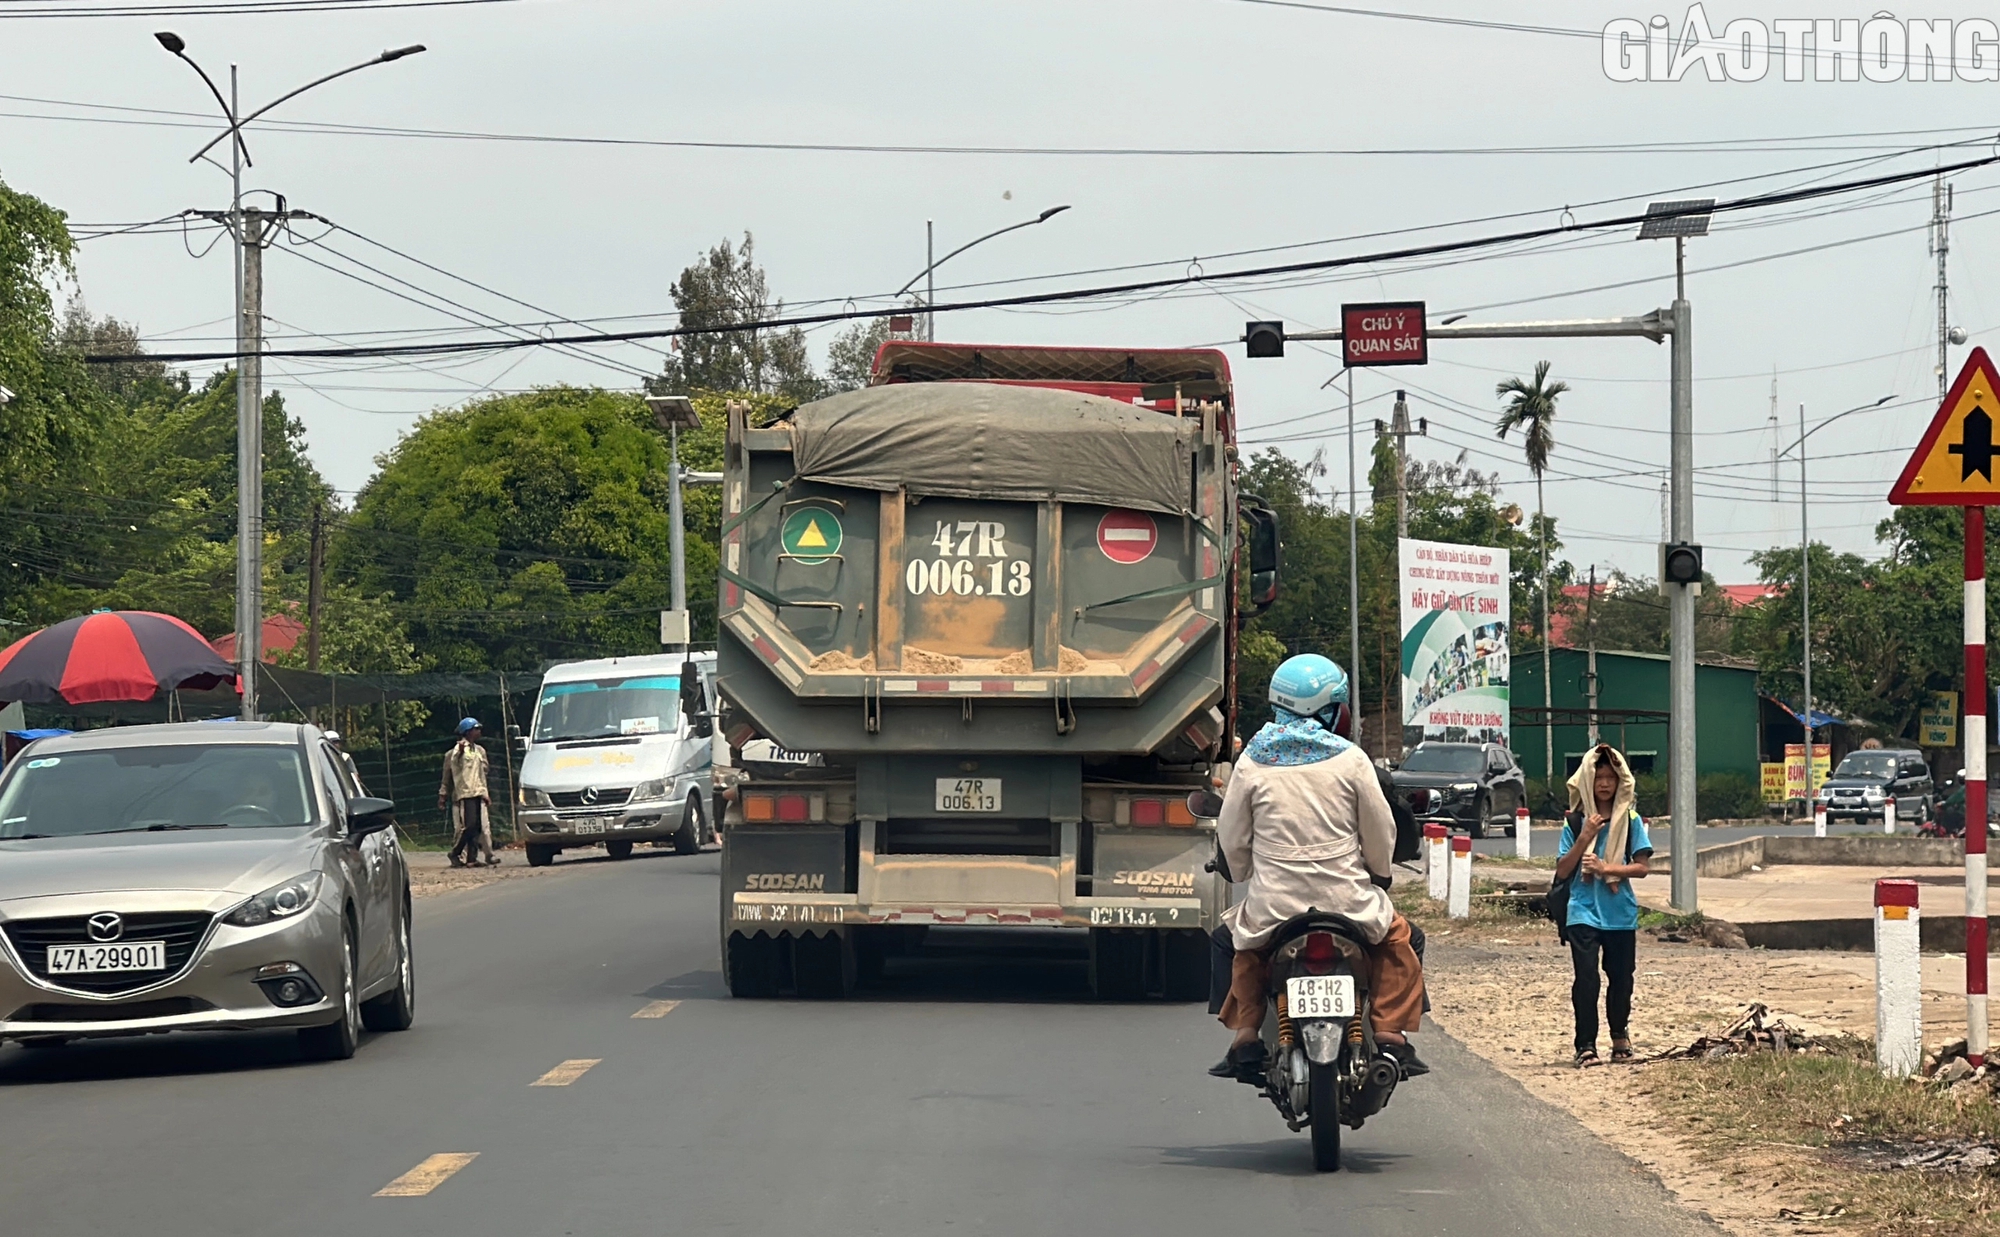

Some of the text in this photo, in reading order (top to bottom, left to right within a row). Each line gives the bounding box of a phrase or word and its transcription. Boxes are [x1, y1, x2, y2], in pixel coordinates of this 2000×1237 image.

[1362, 312, 1406, 331] CHÚ Ý
[1349, 333, 1420, 356] QUAN SÁT
[931, 520, 1008, 557] 47R
[906, 559, 1032, 596] 006.13
[1412, 588, 1499, 616] HÃY GIỮ GÌN VỆ SINH
[1429, 708, 1449, 725] KHÔNG
[1462, 709, 1474, 726] RÁC
[1474, 713, 1483, 726] RA
[955, 779, 983, 794] 47R
[943, 795, 994, 809] 006.13
[745, 873, 825, 890] SOOSAN
[1113, 870, 1195, 887] SOOSAN
[1137, 886, 1194, 895] VINA MOTOR
[52, 945, 158, 971] 47A-299.01
[1297, 997, 1344, 1014] 8599
